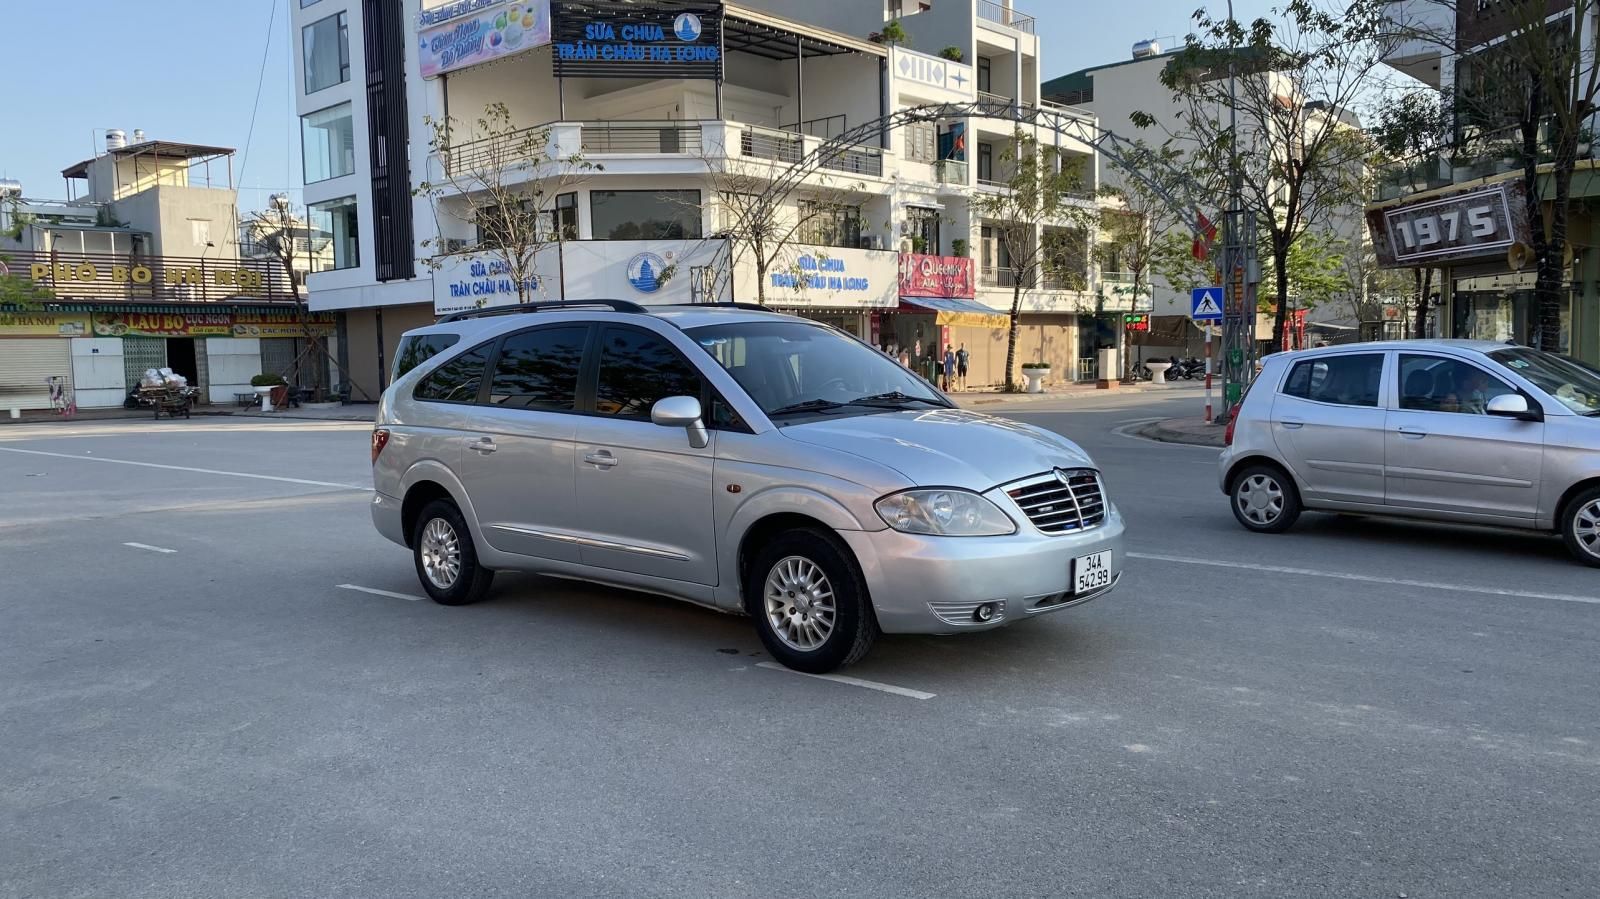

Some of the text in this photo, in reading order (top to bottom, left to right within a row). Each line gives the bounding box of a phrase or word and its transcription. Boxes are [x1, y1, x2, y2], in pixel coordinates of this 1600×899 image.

[584, 21, 665, 41] SỮA CHUA
[557, 40, 720, 63] TRÂN CHÂU HẠ LONG
[1396, 206, 1498, 249] 1975
[112, 263, 152, 283] BÒ
[165, 265, 202, 284] HÀ
[470, 260, 487, 277] SỮA
[450, 276, 538, 297] TRÂN CHÂU HẠ LNG
[843, 277, 870, 291] LONG
[1086, 554, 1102, 572] 34A
[1079, 569, 1108, 590] 542.99
